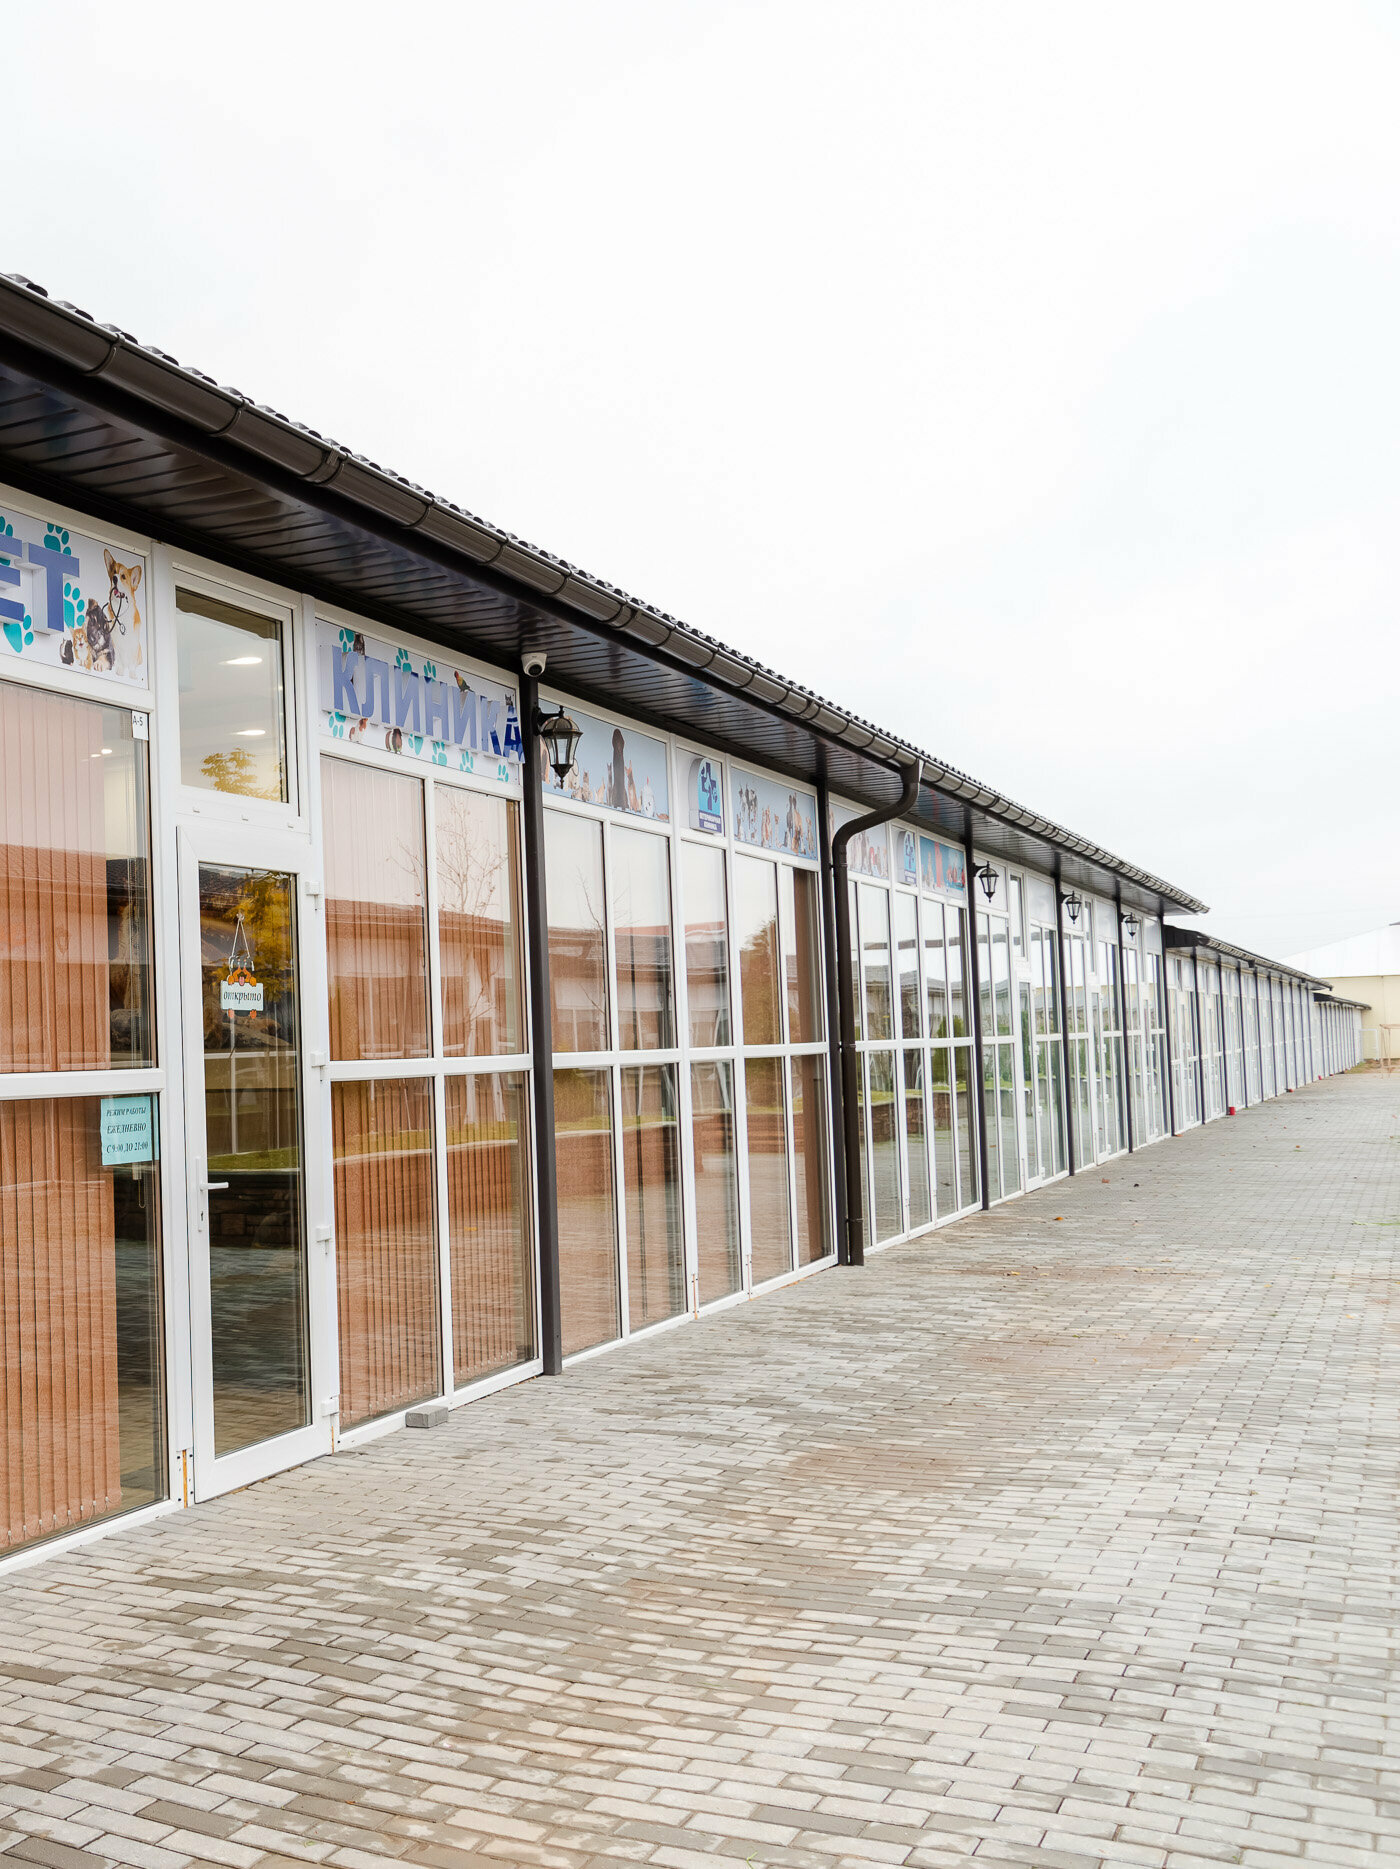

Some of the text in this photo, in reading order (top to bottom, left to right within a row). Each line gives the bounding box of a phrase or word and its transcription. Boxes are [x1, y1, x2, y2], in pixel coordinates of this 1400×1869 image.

[332, 644, 525, 763] КЛИНИКА
[223, 991, 262, 1004] открыто
[107, 1122, 147, 1135] ЕЖЕДНЕВНО
[124, 1142, 133, 1153] ДО
